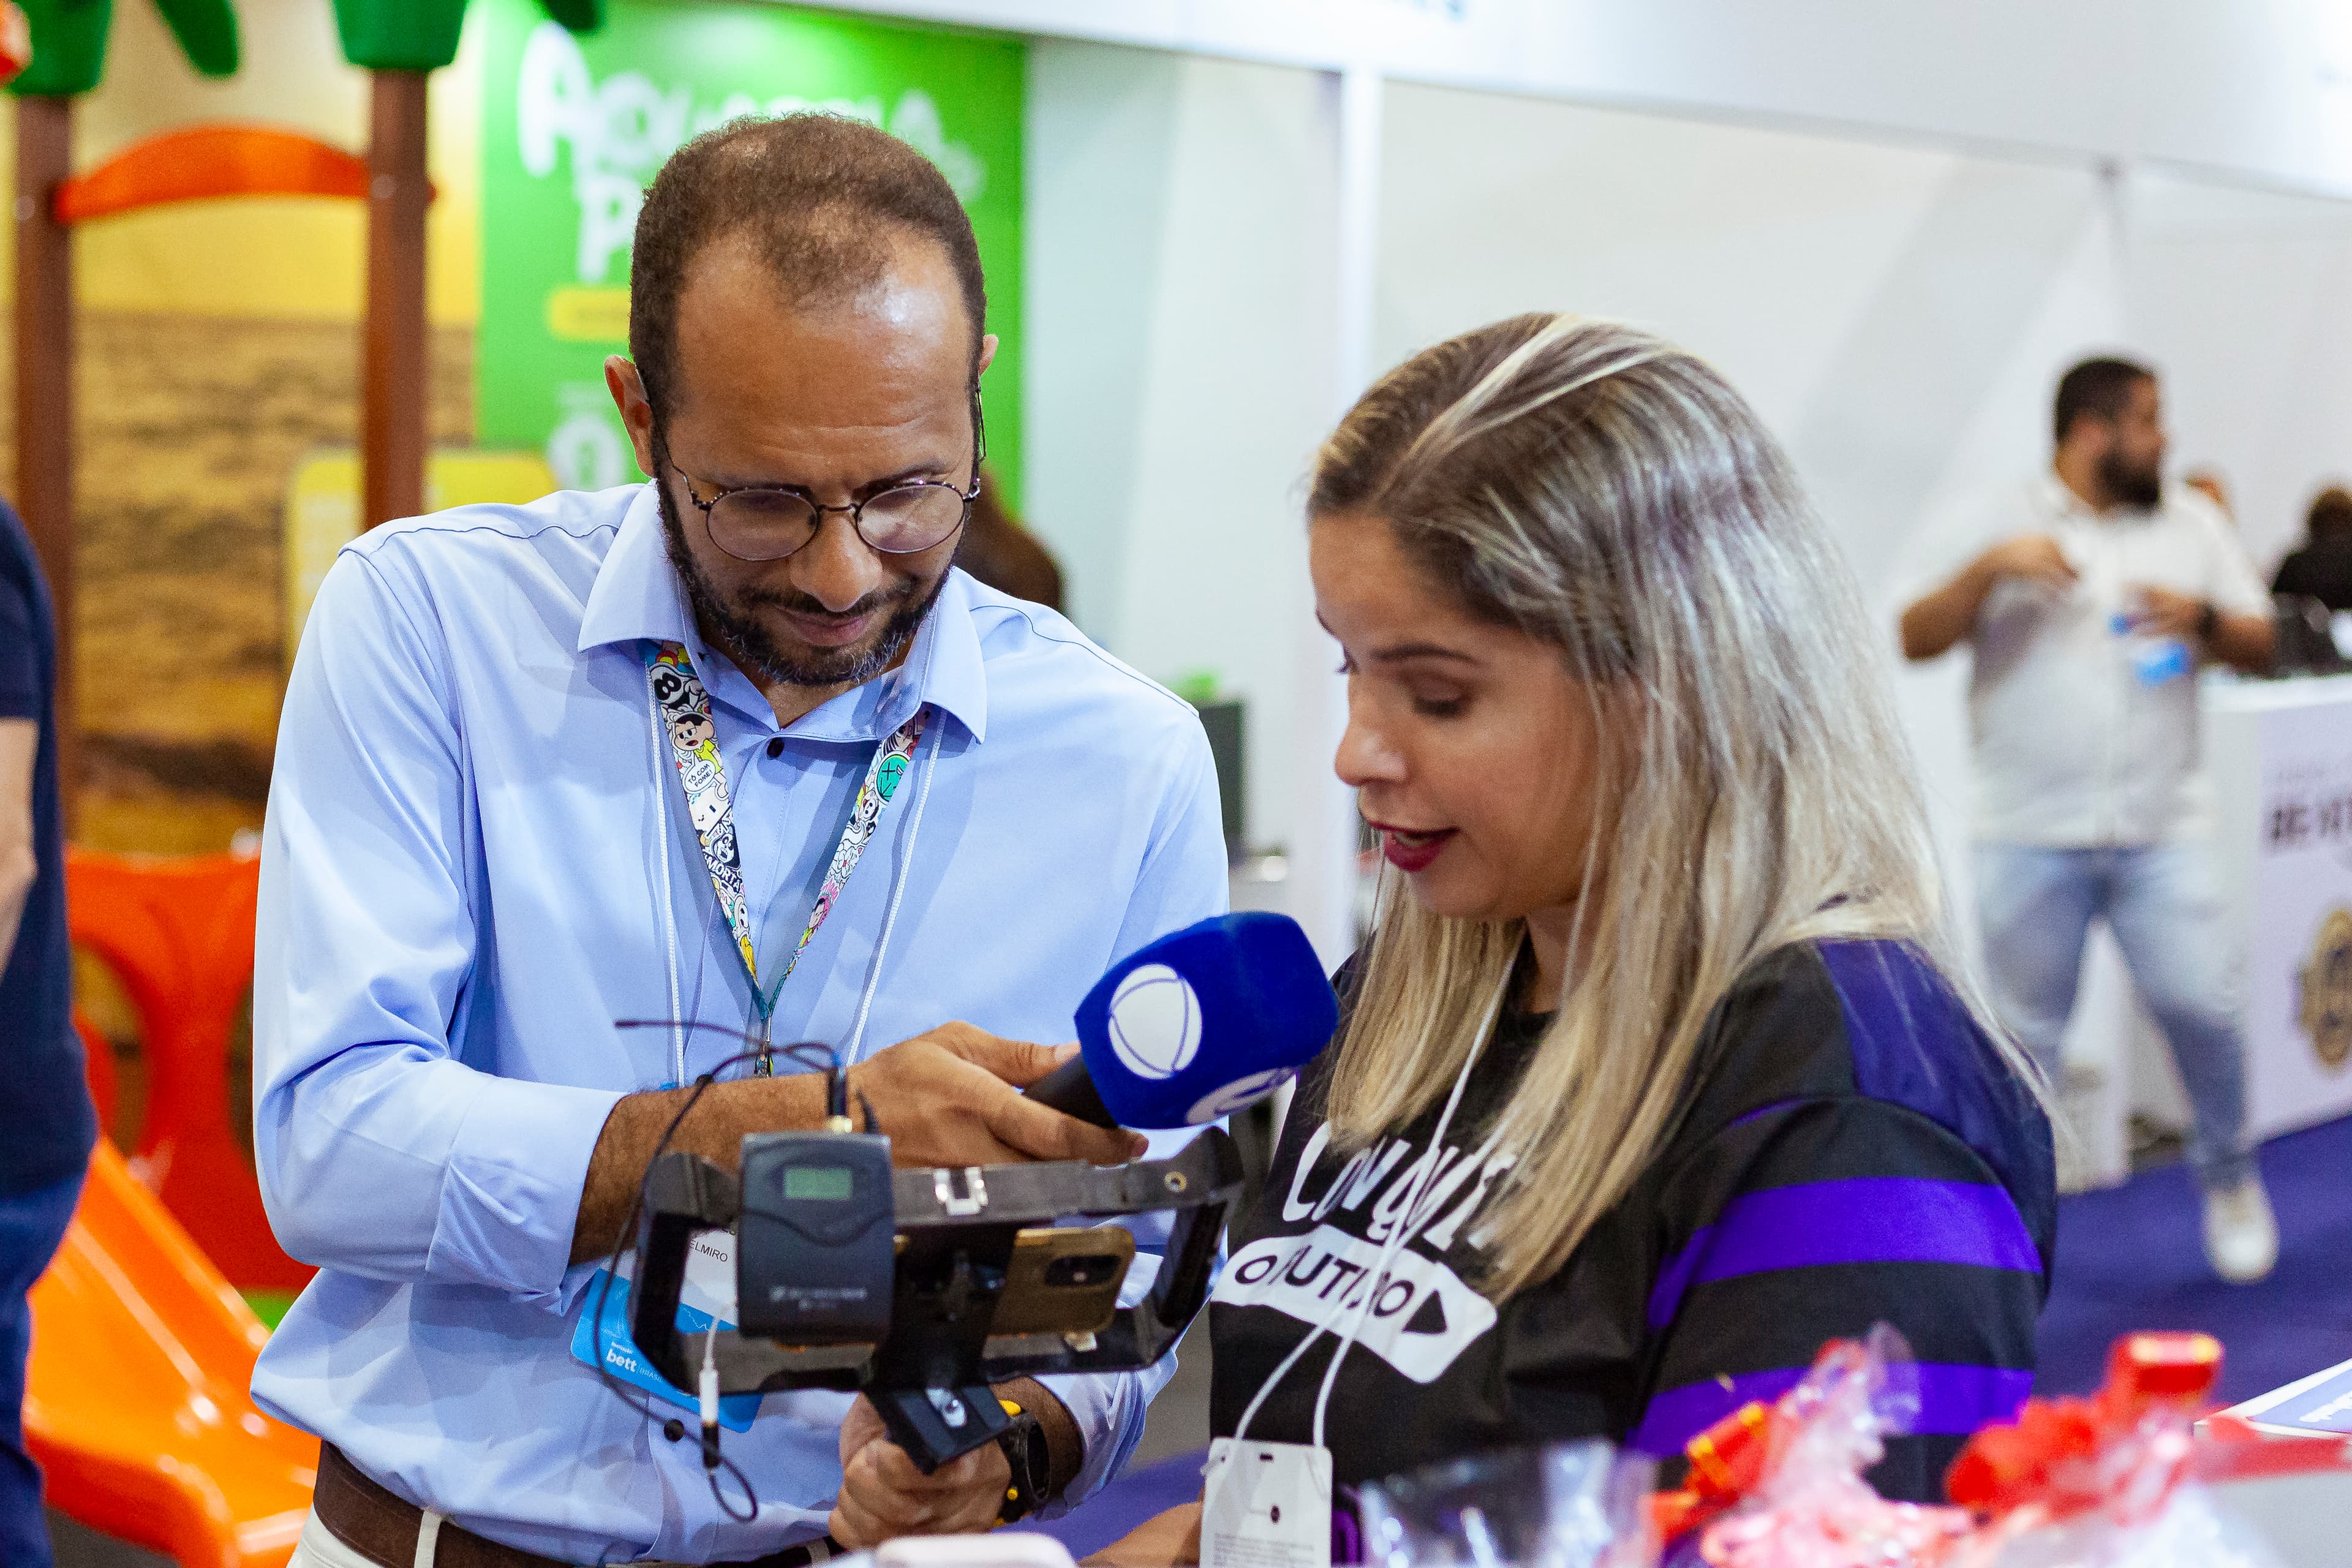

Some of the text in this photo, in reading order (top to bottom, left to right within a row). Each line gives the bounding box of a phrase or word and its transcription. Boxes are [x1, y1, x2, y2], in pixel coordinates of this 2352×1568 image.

[695, 769, 713, 788] FOME!
[697, 764, 710, 777] COM
[606, 1348, 637, 1373] bett
